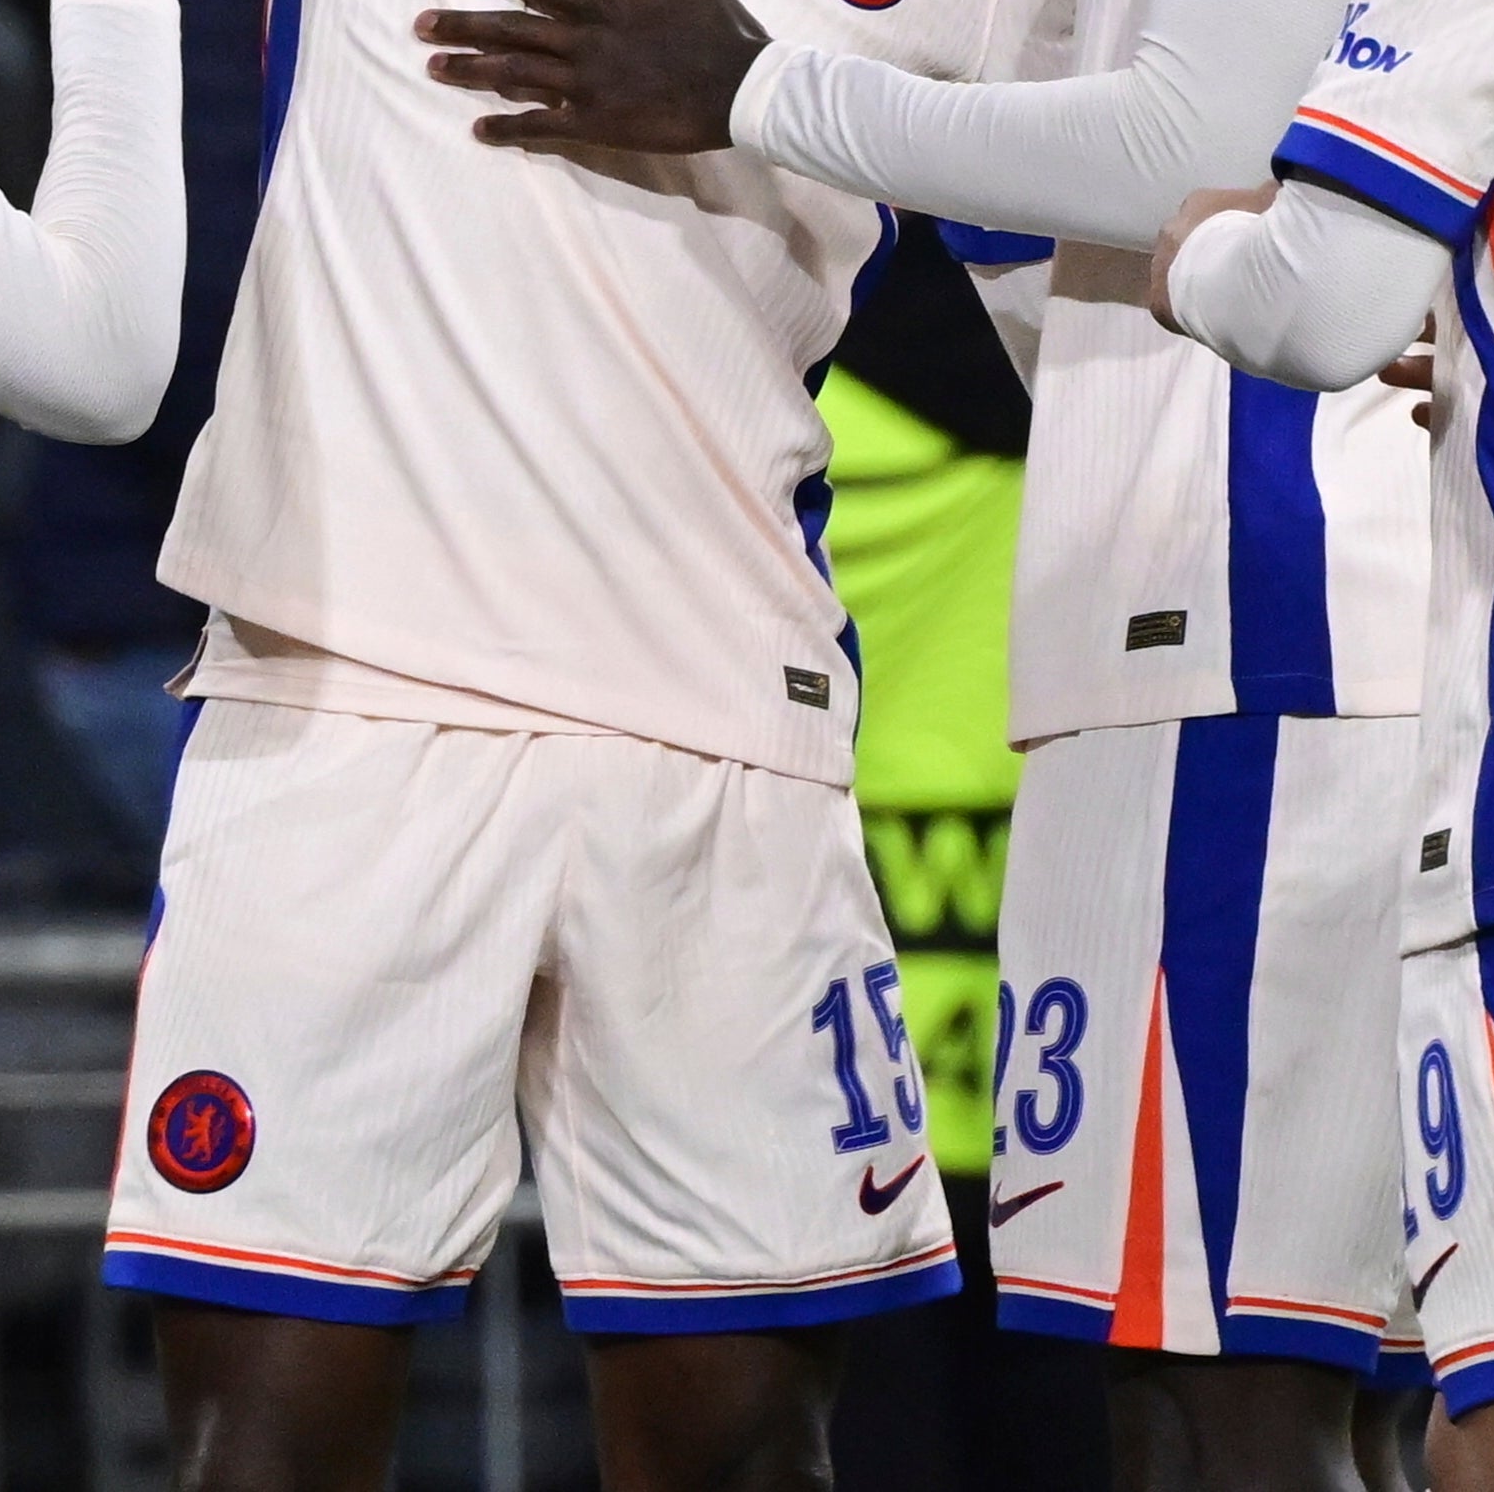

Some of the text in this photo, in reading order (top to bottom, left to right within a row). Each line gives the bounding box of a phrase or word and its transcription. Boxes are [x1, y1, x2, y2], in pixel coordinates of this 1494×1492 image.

[1324, 30, 1413, 74] ION
[811, 958, 924, 1156] 15
[1398, 1039, 1466, 1246] 9
